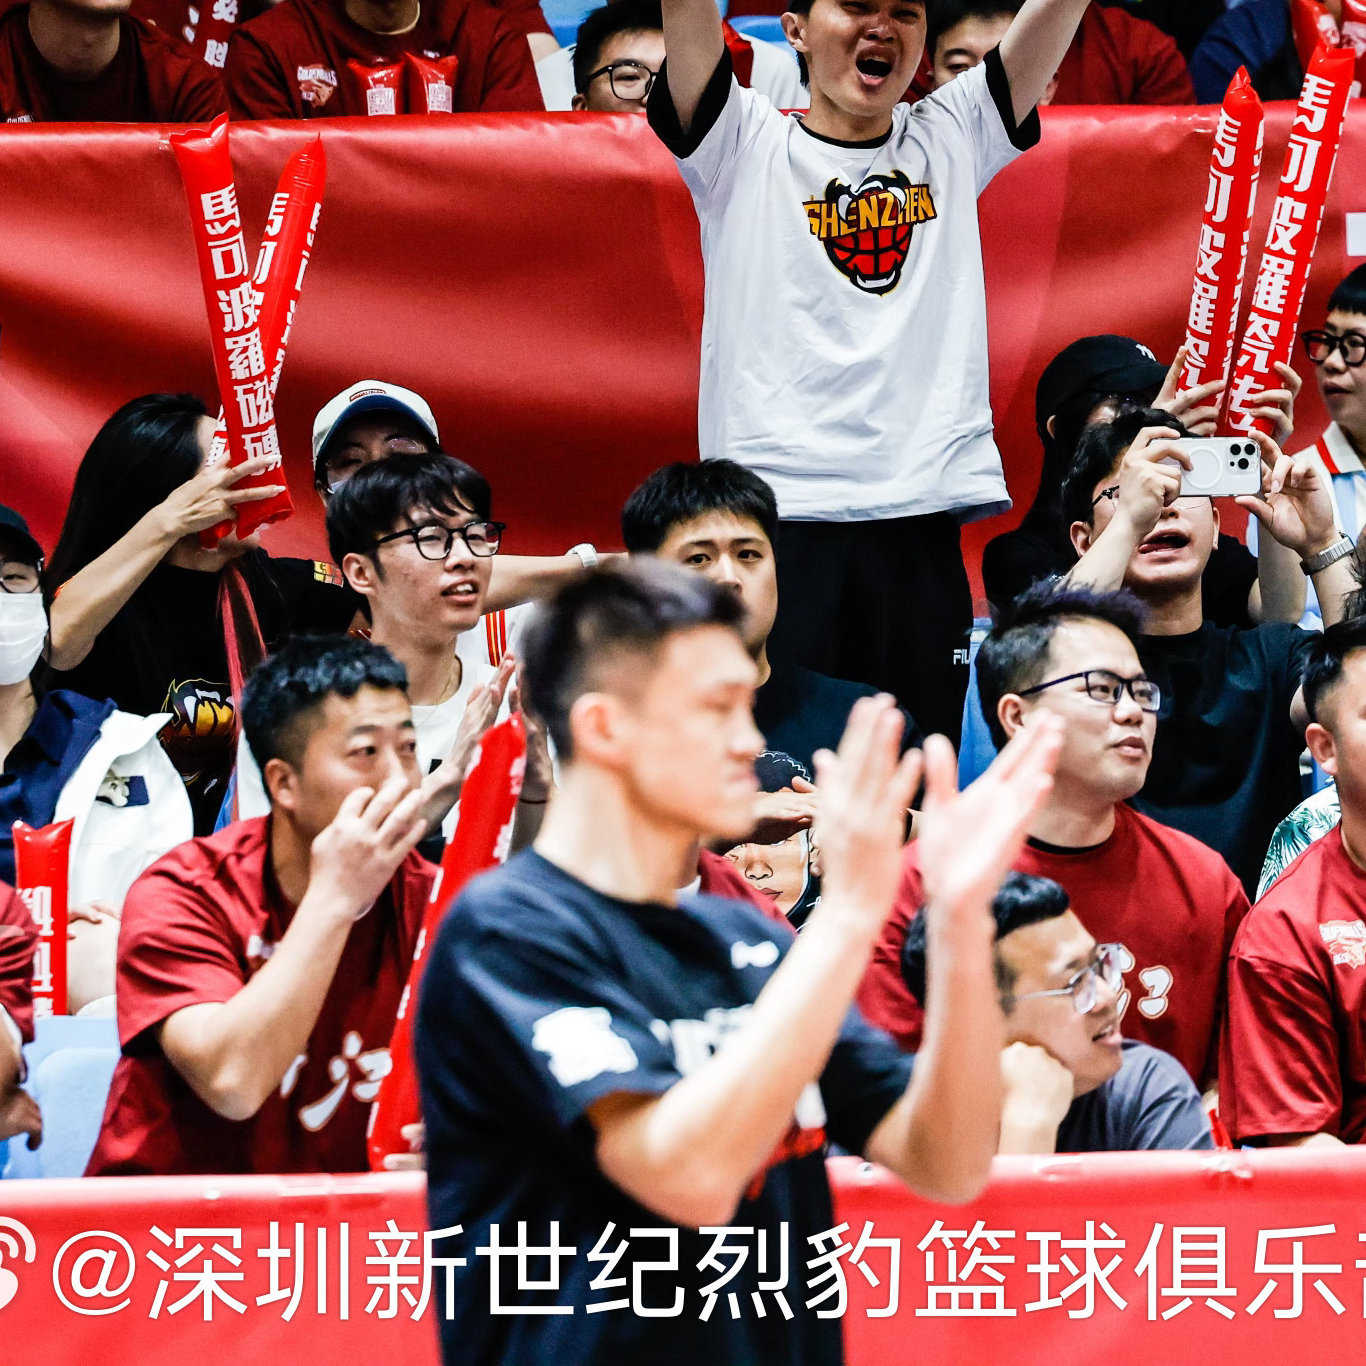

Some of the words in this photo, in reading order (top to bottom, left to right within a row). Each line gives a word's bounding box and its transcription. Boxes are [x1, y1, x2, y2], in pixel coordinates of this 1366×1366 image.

[803, 182, 938, 241] SHENZHEN
[953, 648, 972, 667] FIL
[280, 1031, 393, 1132] 江
